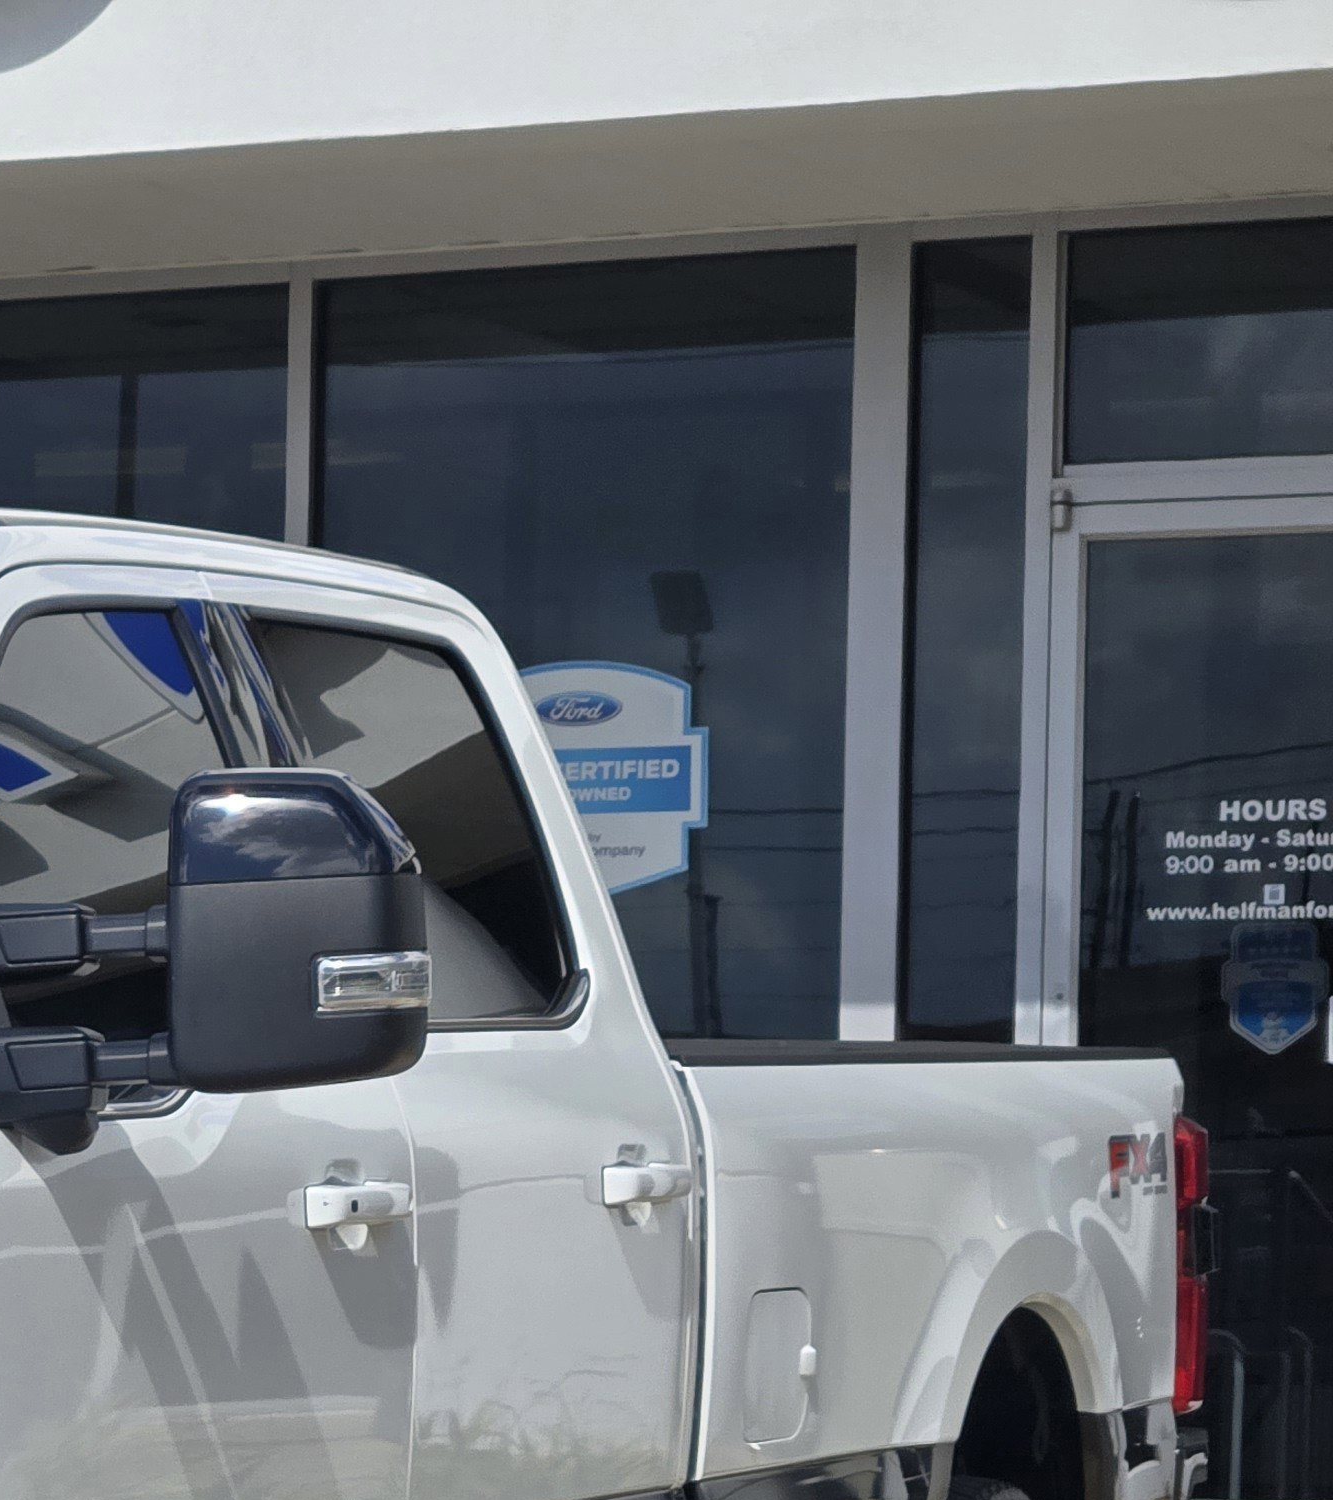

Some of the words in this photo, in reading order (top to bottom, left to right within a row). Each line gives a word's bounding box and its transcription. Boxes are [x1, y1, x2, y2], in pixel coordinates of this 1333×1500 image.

[549, 696, 604, 721] Ford
[1219, 798, 1327, 822] HOURS
[591, 845, 646, 858] ompany
[1165, 830, 1255, 851] Monday
[1165, 854, 1215, 875] 9:00
[1223, 857, 1261, 873] am
[1108, 1131, 1168, 1199] FX4
